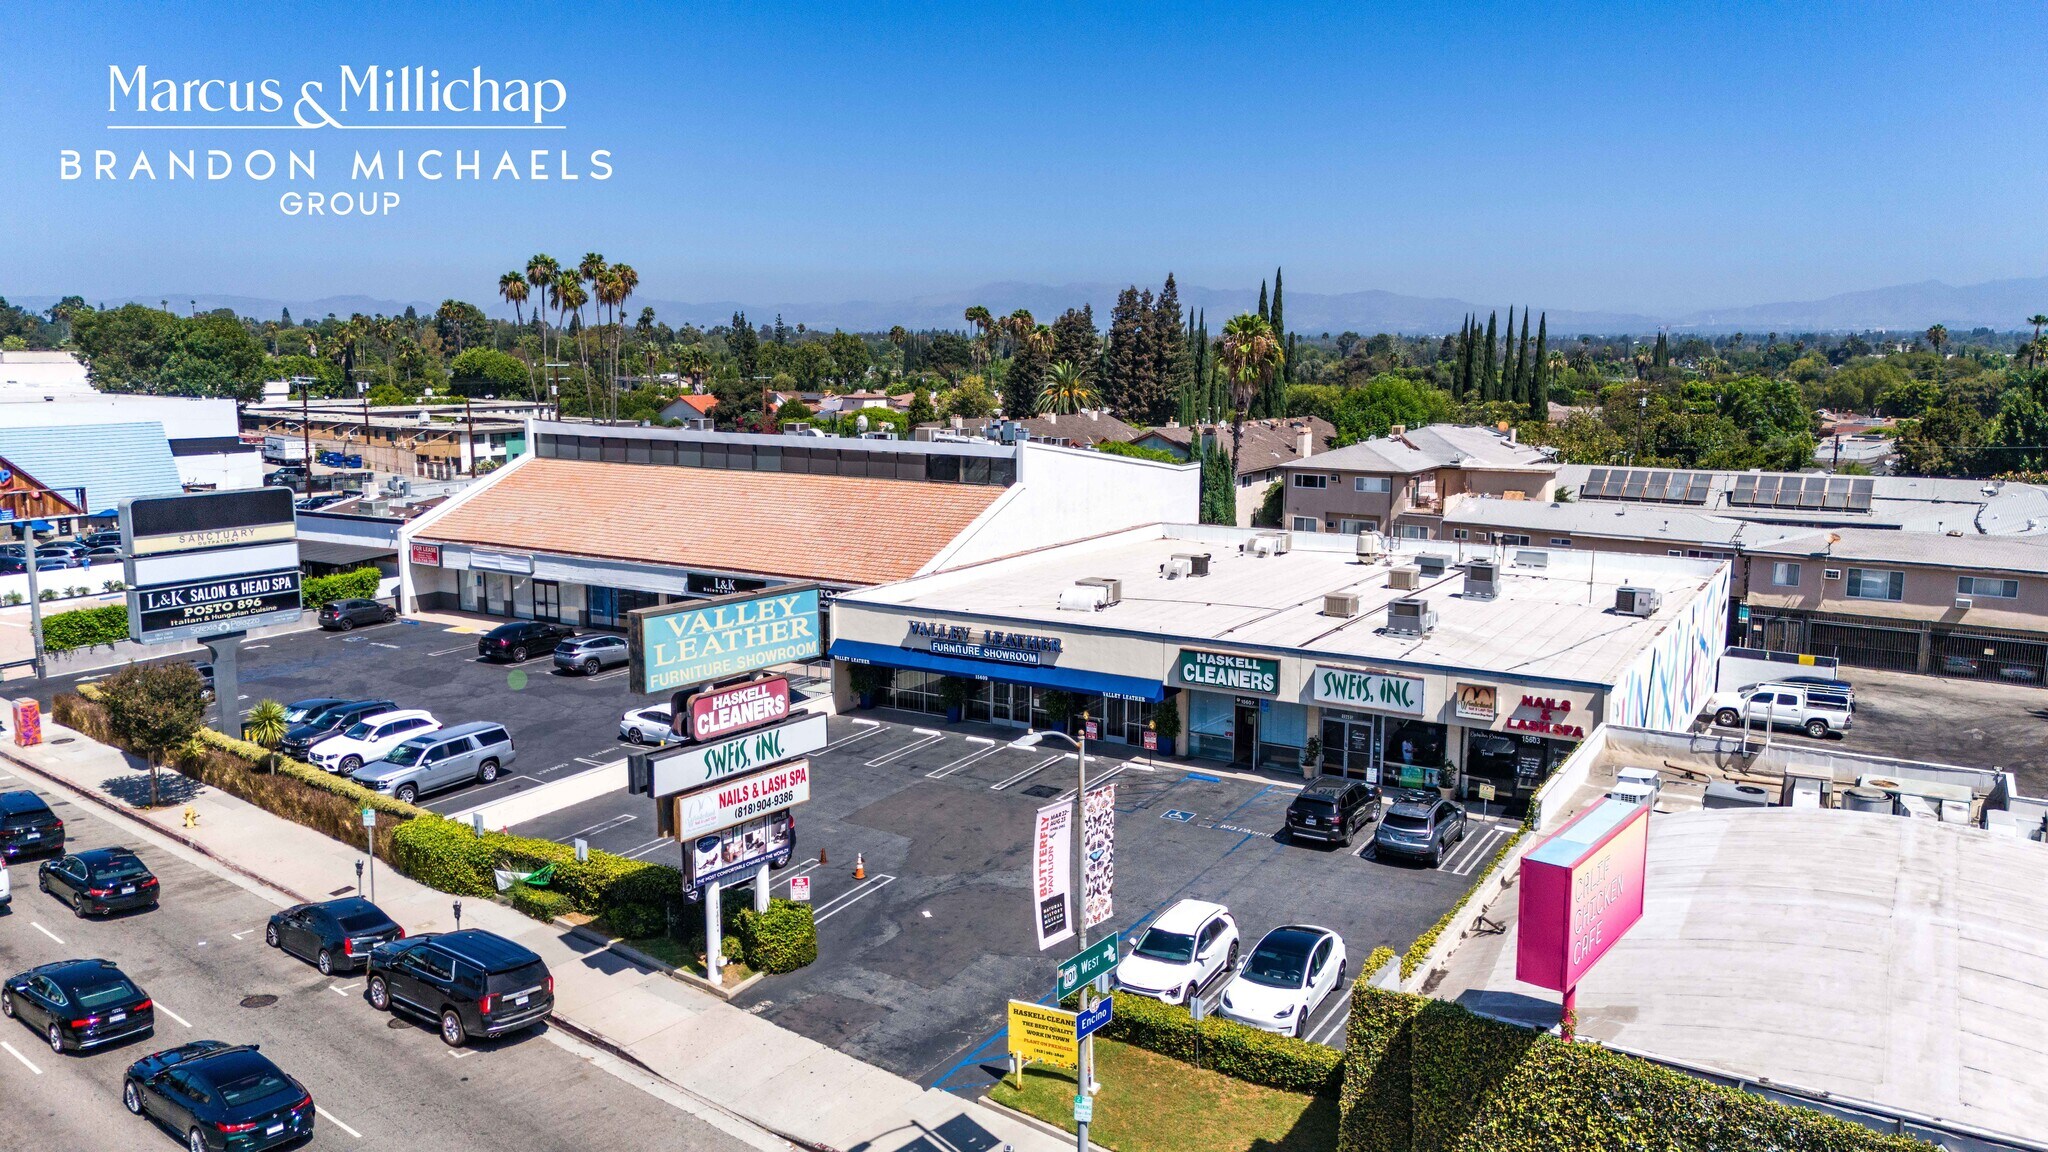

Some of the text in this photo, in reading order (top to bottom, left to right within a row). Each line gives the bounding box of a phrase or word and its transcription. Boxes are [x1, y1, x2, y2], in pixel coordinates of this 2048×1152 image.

[179, 528, 256, 544] SANCTUARY
[198, 537, 240, 546] OUTPATIENT
[148, 576, 292, 610] L&K SALON & HEAD SPA
[714, 577, 735, 591] L&K
[170, 616, 203, 626] Italian
[211, 610, 249, 621] Hungarian
[250, 605, 277, 614] Cuisine
[183, 598, 262, 617] POSTO 896
[665, 596, 800, 638] VALLEY
[654, 617, 814, 668] LEATHER
[908, 620, 1064, 653] VALLEY LEATHER
[834, 654, 871, 665] VALLEY LEATHER
[932, 642, 1037, 664] FURNITURE SHOWROOM
[1196, 652, 1261, 670] HASKELL
[651, 641, 817, 688] FURNITURE SHOWROOM
[1183, 663, 1274, 692] CLEANERS
[712, 685, 770, 711] HASKELL
[1102, 691, 1146, 703] VALLEY LEATHER
[1521, 694, 1571, 712] NAILS
[697, 694, 786, 735] CLEANERS
[1541, 708, 1552, 721] &
[1507, 717, 1584, 738] LASH SPA
[1521, 735, 1541, 745] 15603
[719, 768, 806, 809] NAILS & LASH SPA
[1039, 816, 1049, 898] BUTTERFLY
[705, 873, 717, 882] MOST
[717, 863, 746, 877] COMFORTABLE
[746, 858, 761, 867] CHAIRS
[1575, 854, 1611, 903] CALIF
[1043, 902, 1063, 914] NATURAL
[1043, 907, 1063, 919] HISTORY
[1574, 873, 1624, 935] CHICKEN
[1573, 920, 1604, 966] CAFE
[1065, 956, 1100, 984] 101 WEST
[1013, 1008, 1076, 1028] HASKELL CLEANE
[1022, 1020, 1074, 1036] THE BEST QUALITY
[1082, 1009, 1107, 1030] Encino
[1023, 1037, 1040, 1046] PLANT
[1048, 1043, 1073, 1052] PREMISES
[1026, 1029, 1045, 1038] WORK
[1052, 1035, 1070, 1043] TOWN
